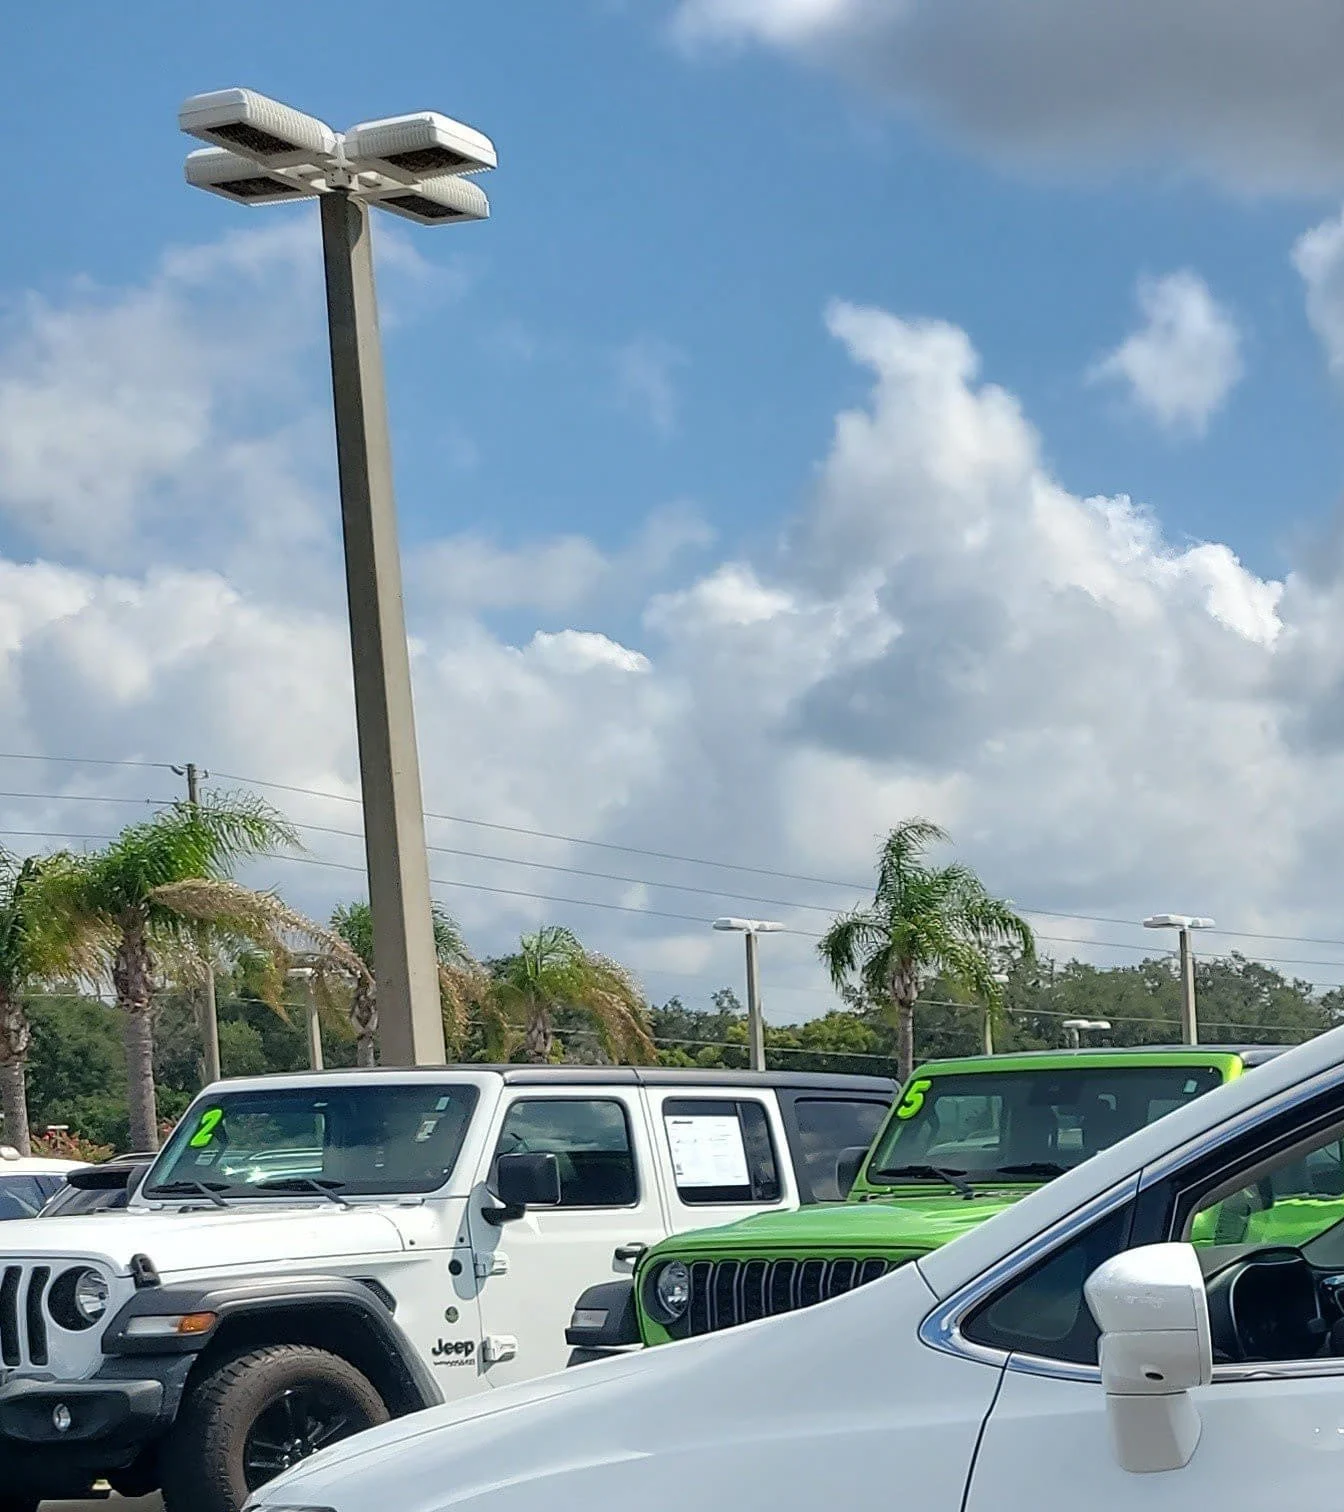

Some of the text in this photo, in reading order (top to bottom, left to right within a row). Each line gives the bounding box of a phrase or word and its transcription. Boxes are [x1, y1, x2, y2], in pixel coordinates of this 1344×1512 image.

[897, 1080, 932, 1119] 5
[190, 1109, 222, 1147] 2
[431, 1338, 474, 1357] Jeep
